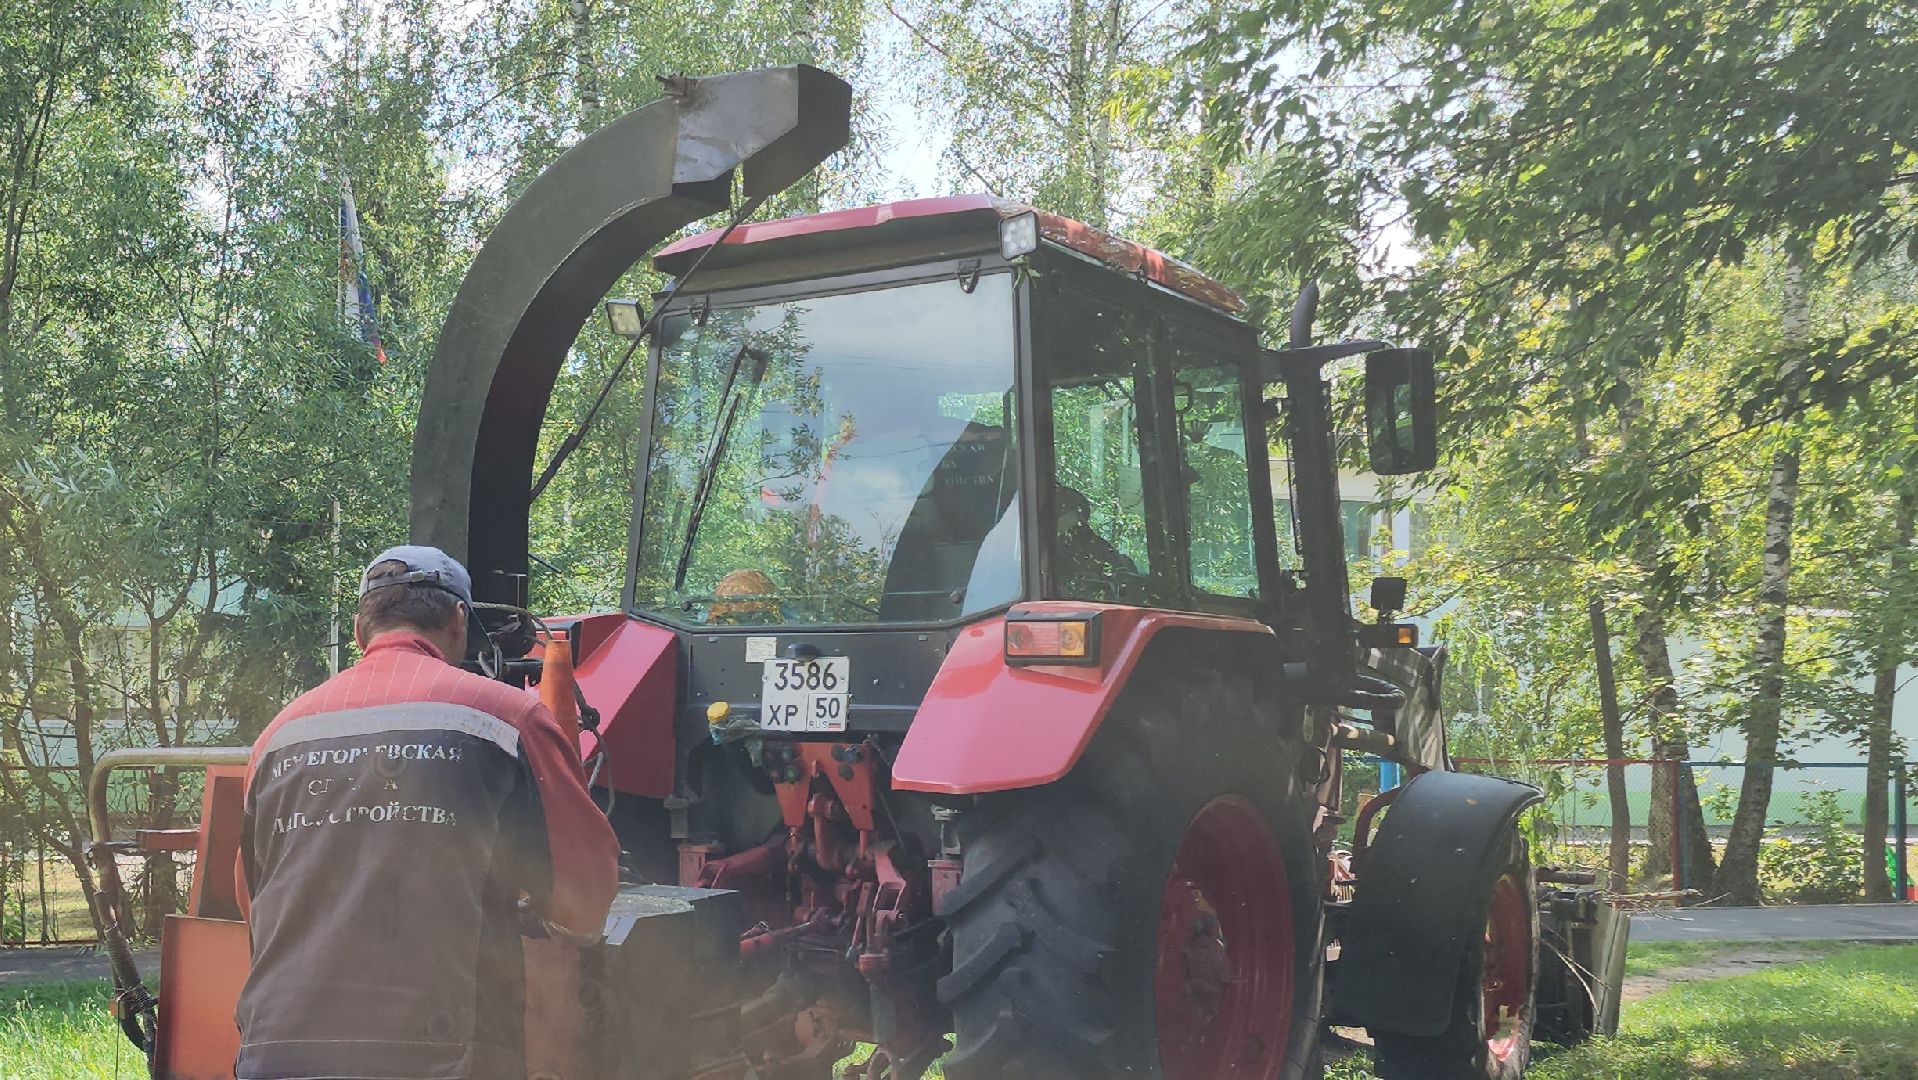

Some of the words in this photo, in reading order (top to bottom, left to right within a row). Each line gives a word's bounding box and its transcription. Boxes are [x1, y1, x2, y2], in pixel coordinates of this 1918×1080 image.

[774, 661, 837, 691] 3586
[767, 704, 799, 726] ХР
[815, 697, 840, 719] 50
[808, 720, 828, 729] RUS
[306, 743, 463, 767] ЕГОРЕВСКАЯ
